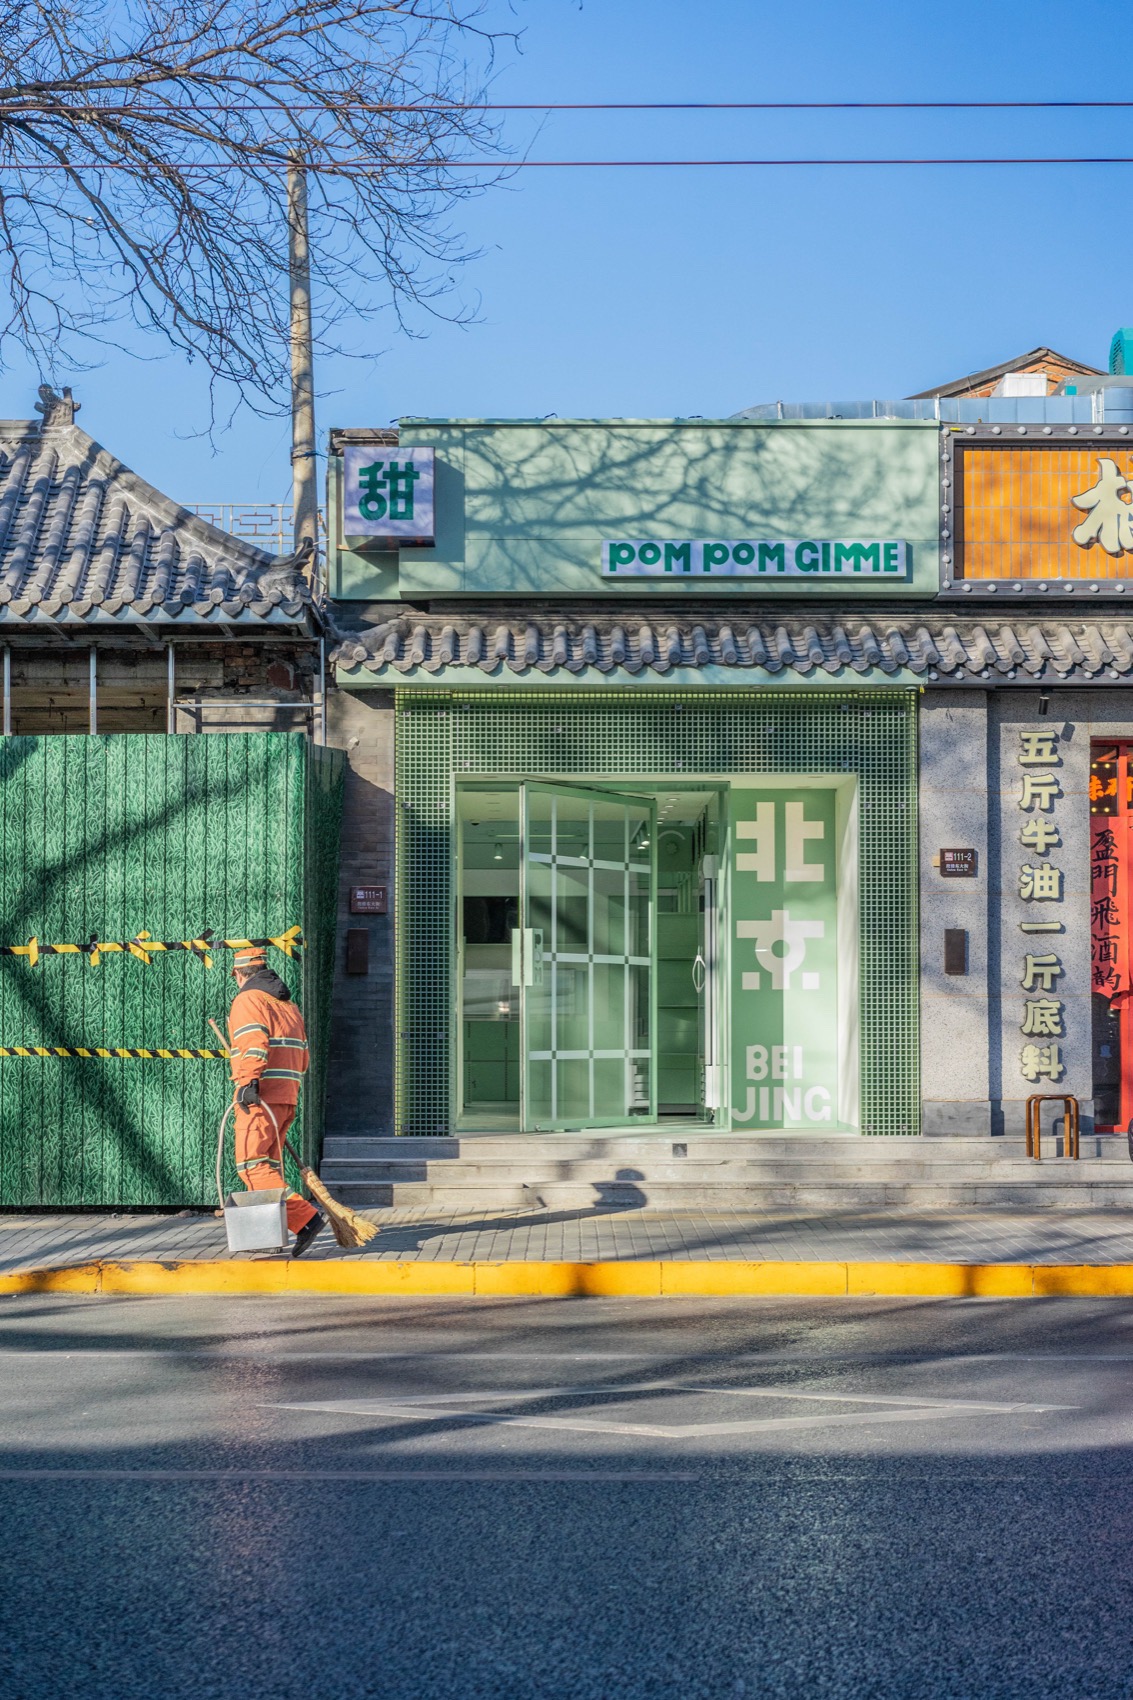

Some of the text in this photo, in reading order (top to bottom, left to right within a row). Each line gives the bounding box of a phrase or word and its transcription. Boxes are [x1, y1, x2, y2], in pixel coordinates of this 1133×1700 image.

[358, 461, 420, 521] 甜
[608, 541, 899, 572] POM POM GIMME
[953, 852, 972, 861] 111-2
[365, 891, 383, 899] 111-1
[736, 801, 825, 990] 北京
[1018, 730, 1063, 1081] 五斤牛油一斤底料
[746, 1044, 803, 1081] BEI
[731, 1085, 832, 1122] JING
